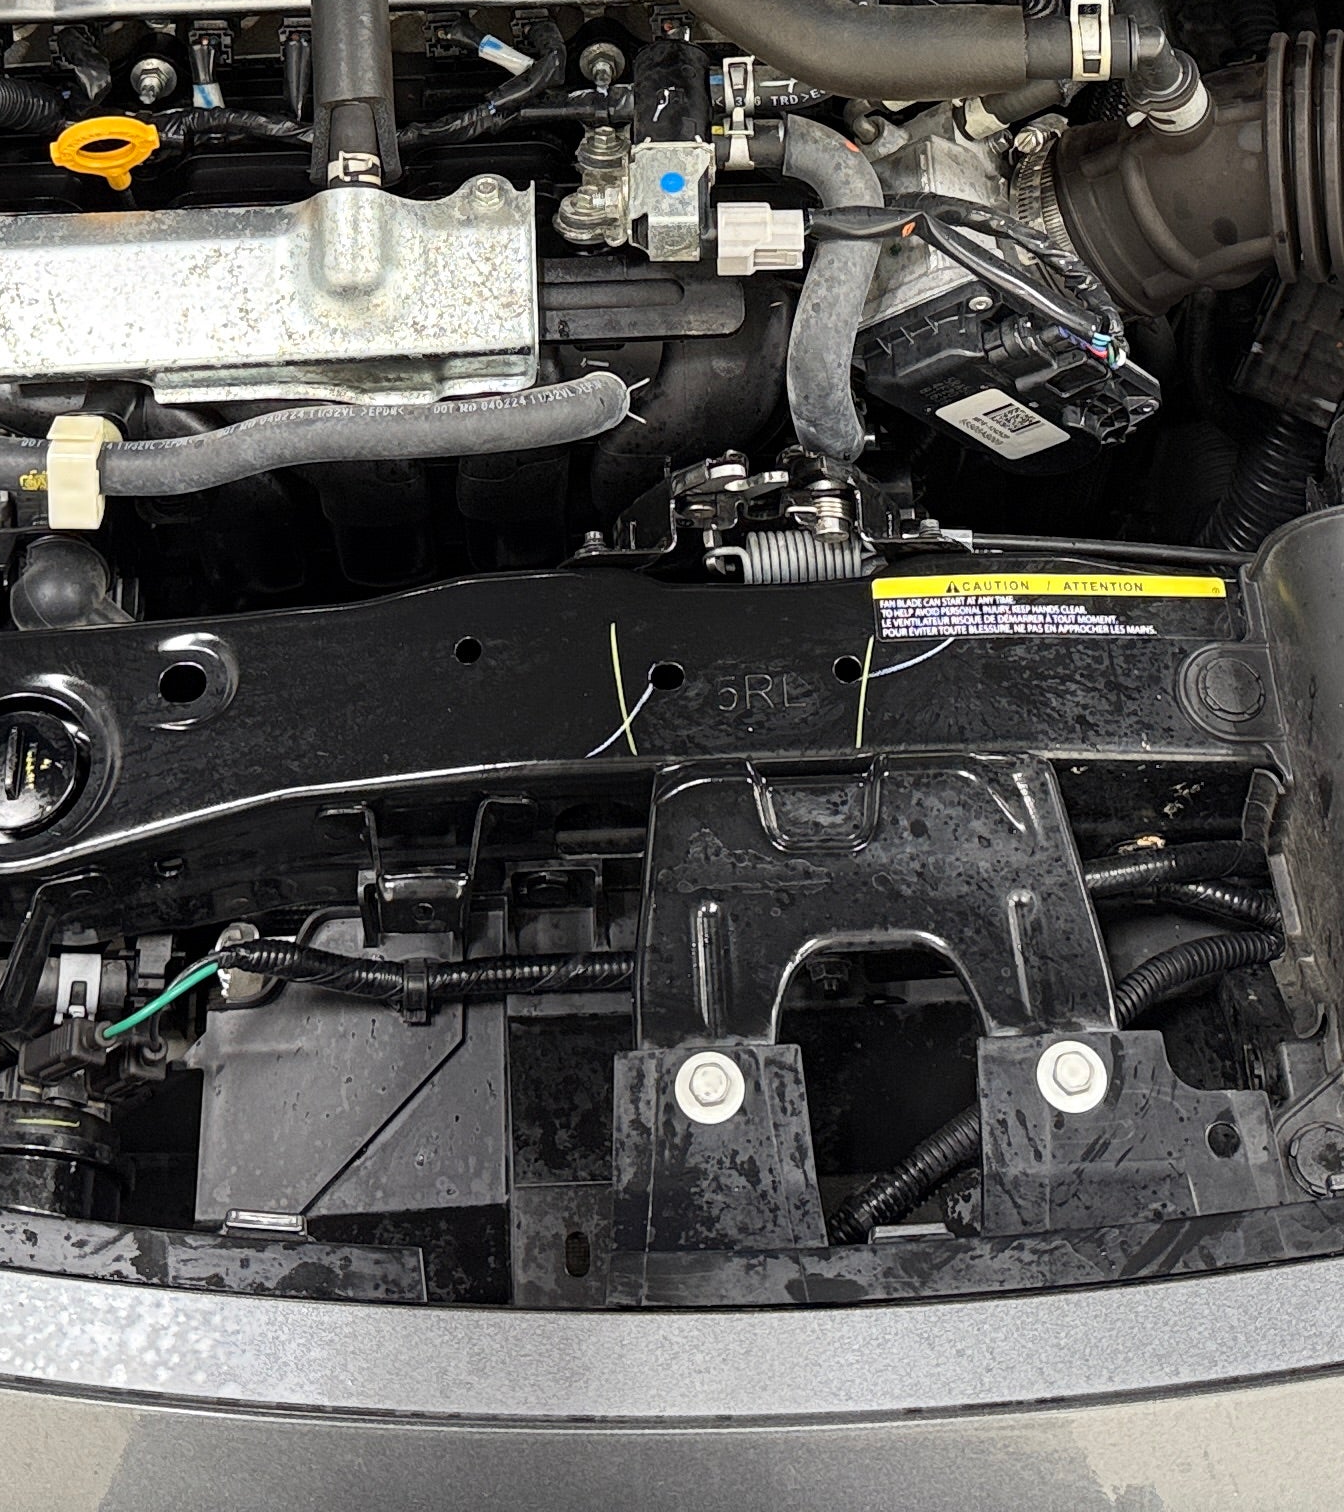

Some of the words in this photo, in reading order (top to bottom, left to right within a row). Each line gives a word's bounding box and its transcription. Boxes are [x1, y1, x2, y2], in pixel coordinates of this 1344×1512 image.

[481, 396, 527, 411] 040224
[962, 581, 1030, 592] CAUTION
[1063, 581, 1144, 592] ATTENTION
[879, 600, 896, 609] FAN
[896, 599, 922, 608] BLADE
[922, 598, 941, 607] CAN
[941, 596, 966, 606] START
[966, 596, 976, 605] AT
[977, 596, 994, 604] ANY
[881, 609, 893, 618] TO
[893, 608, 914, 618] HELP
[915, 608, 940, 617] AVOID
[941, 606, 982, 616] PERSONAL
[1011, 605, 1031, 614] KEEP
[1031, 605, 1059, 614] HANDS
[1060, 605, 1087, 615] CLEAR.
[881, 619, 892, 628] LE
[893, 616, 950, 627] VENTILATEUR
[951, 615, 983, 625] RISQUE
[983, 615, 997, 624] DE
[997, 613, 1043, 625] DÉMARRER
[1044, 613, 1052, 623] À
[1053, 615, 1077, 624] TOUT
[1077, 615, 1119, 625] MOMENT.
[882, 628, 908, 637] POUR
[909, 625, 938, 636] ÉVITER
[939, 626, 967, 635] TOUTE
[968, 624, 1013, 635] BLESSURE,
[1013, 624, 1026, 634] NE
[1027, 624, 1043, 634] PAS
[1044, 624, 1056, 634] EN
[1057, 624, 1109, 634] APPROCHER
[1110, 624, 1126, 634] LES
[1126, 625, 1157, 635] MAINS.
[718, 674, 807, 711] 5RL
